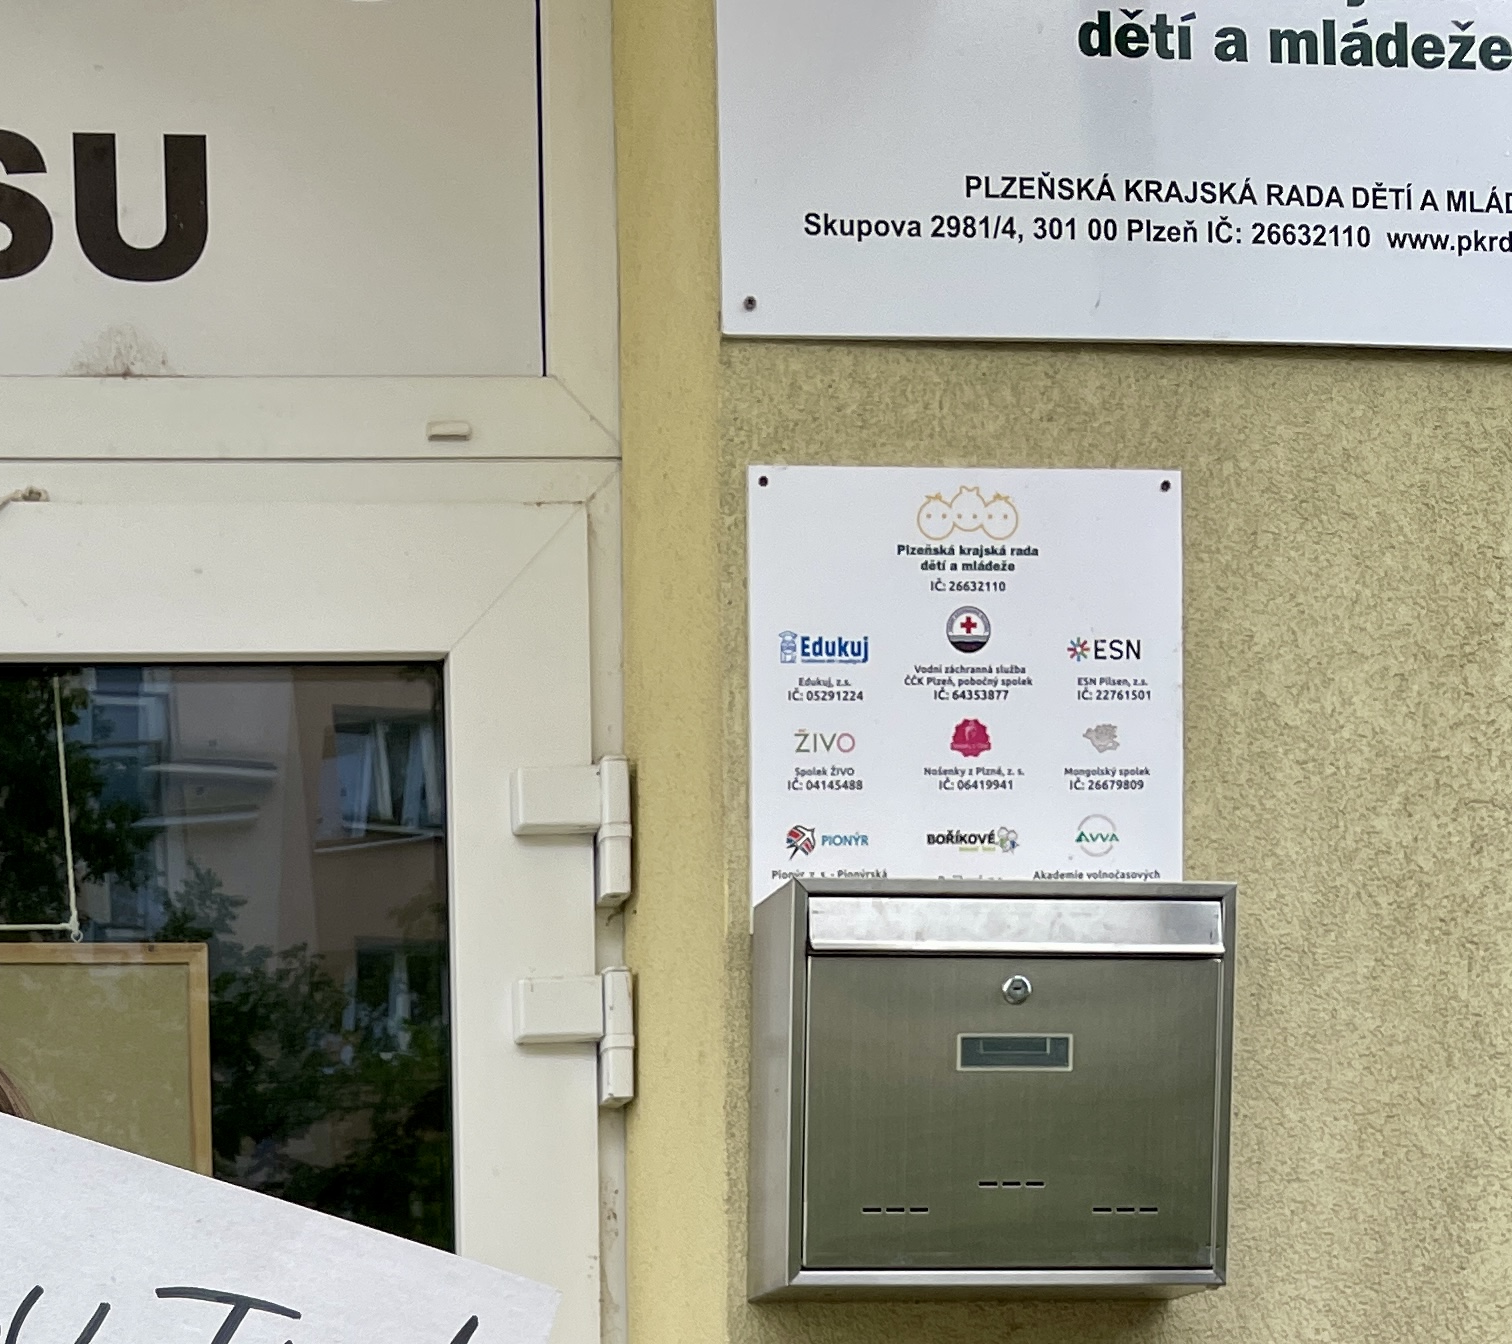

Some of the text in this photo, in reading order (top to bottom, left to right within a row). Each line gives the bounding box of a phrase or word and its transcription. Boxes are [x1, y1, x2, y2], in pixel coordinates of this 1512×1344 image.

[1078, 9, 1512, 71] dětí a mládeže
[965, 172, 1117, 203] PLZEŇSKÁ
[1124, 177, 1258, 206] KRAJSKÁ
[1266, 183, 1345, 209] RADA
[1352, 181, 1413, 211] DĚTÍ
[1419, 189, 1440, 212] A
[803, 213, 922, 242] Skupova
[930, 215, 1025, 244] 2981/4,
[1032, 217, 1077, 240] 301
[1087, 218, 1118, 241] 00
[1126, 219, 1198, 244] Plzeň
[1207, 216, 1242, 244] IČ:
[1251, 222, 1371, 248] 26632110
[896, 544, 1040, 559] Plzeňská krajská rada
[920, 559, 1016, 572] dětí a mládeže
[930, 578, 1006, 592] IČ: 26632110
[800, 636, 870, 663] Edukuj
[1093, 639, 1141, 660] ESN
[914, 664, 1027, 674] Vodní záchranná služba
[957, 676, 998, 688] pobočný
[1000, 676, 1033, 688] spolek
[1077, 677, 1097, 686] ESN
[1099, 676, 1131, 688] Pilsen,
[787, 687, 864, 701] IČ: 05291224
[933, 687, 1009, 701] IČ: 64353877
[1077, 687, 1152, 701] IČ: 22761501
[793, 728, 856, 753] ŽIVO
[794, 765, 856, 779] Spolek ŽIVO
[1063, 767, 1151, 778] Mongolský spolek
[787, 777, 804, 790] IČ:
[938, 777, 1014, 791] IČ: 06419941
[1070, 777, 1144, 790] IČ: 26679809
[821, 831, 869, 847] PIONÝR
[926, 829, 996, 845] BOŘÍKOVÉ
[1033, 870, 1084, 880] Akademie
